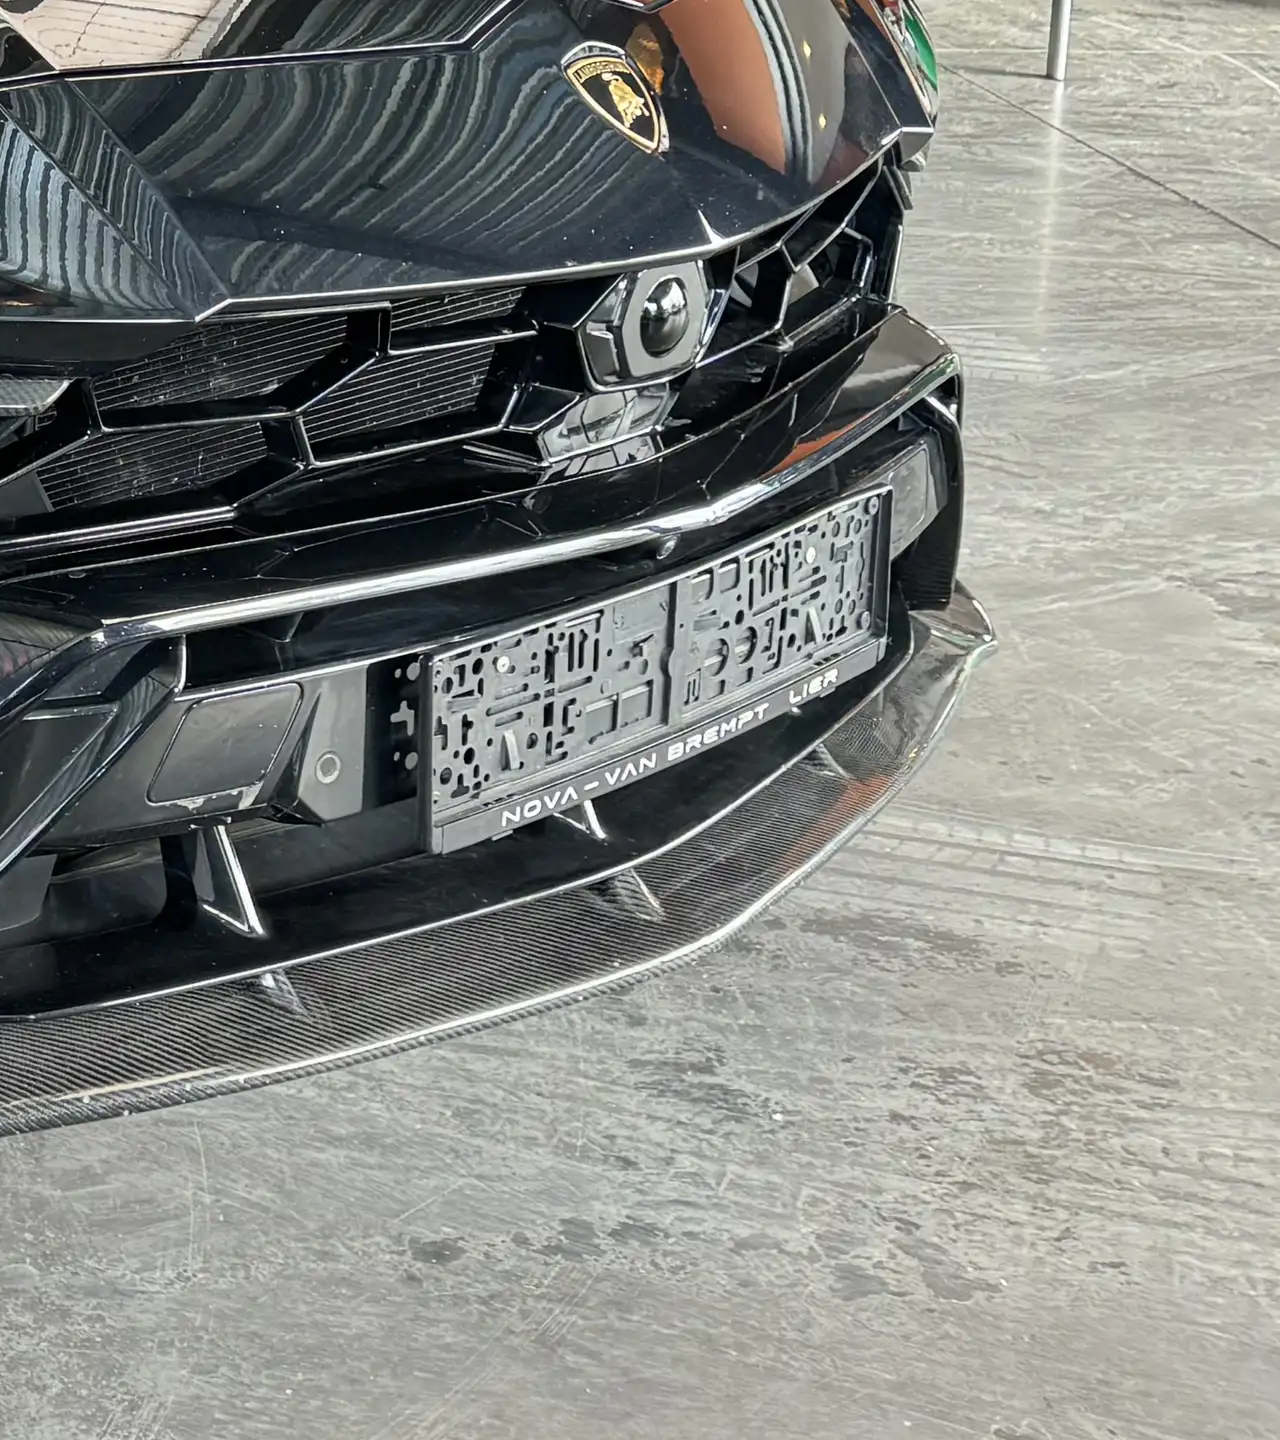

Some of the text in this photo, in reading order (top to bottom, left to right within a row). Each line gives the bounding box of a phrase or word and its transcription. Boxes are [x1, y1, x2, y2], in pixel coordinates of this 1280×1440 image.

[500, 786, 579, 828] NOVA
[604, 752, 658, 786] VAN
[666, 702, 770, 761] BREMPT
[788, 667, 839, 705] LIER
